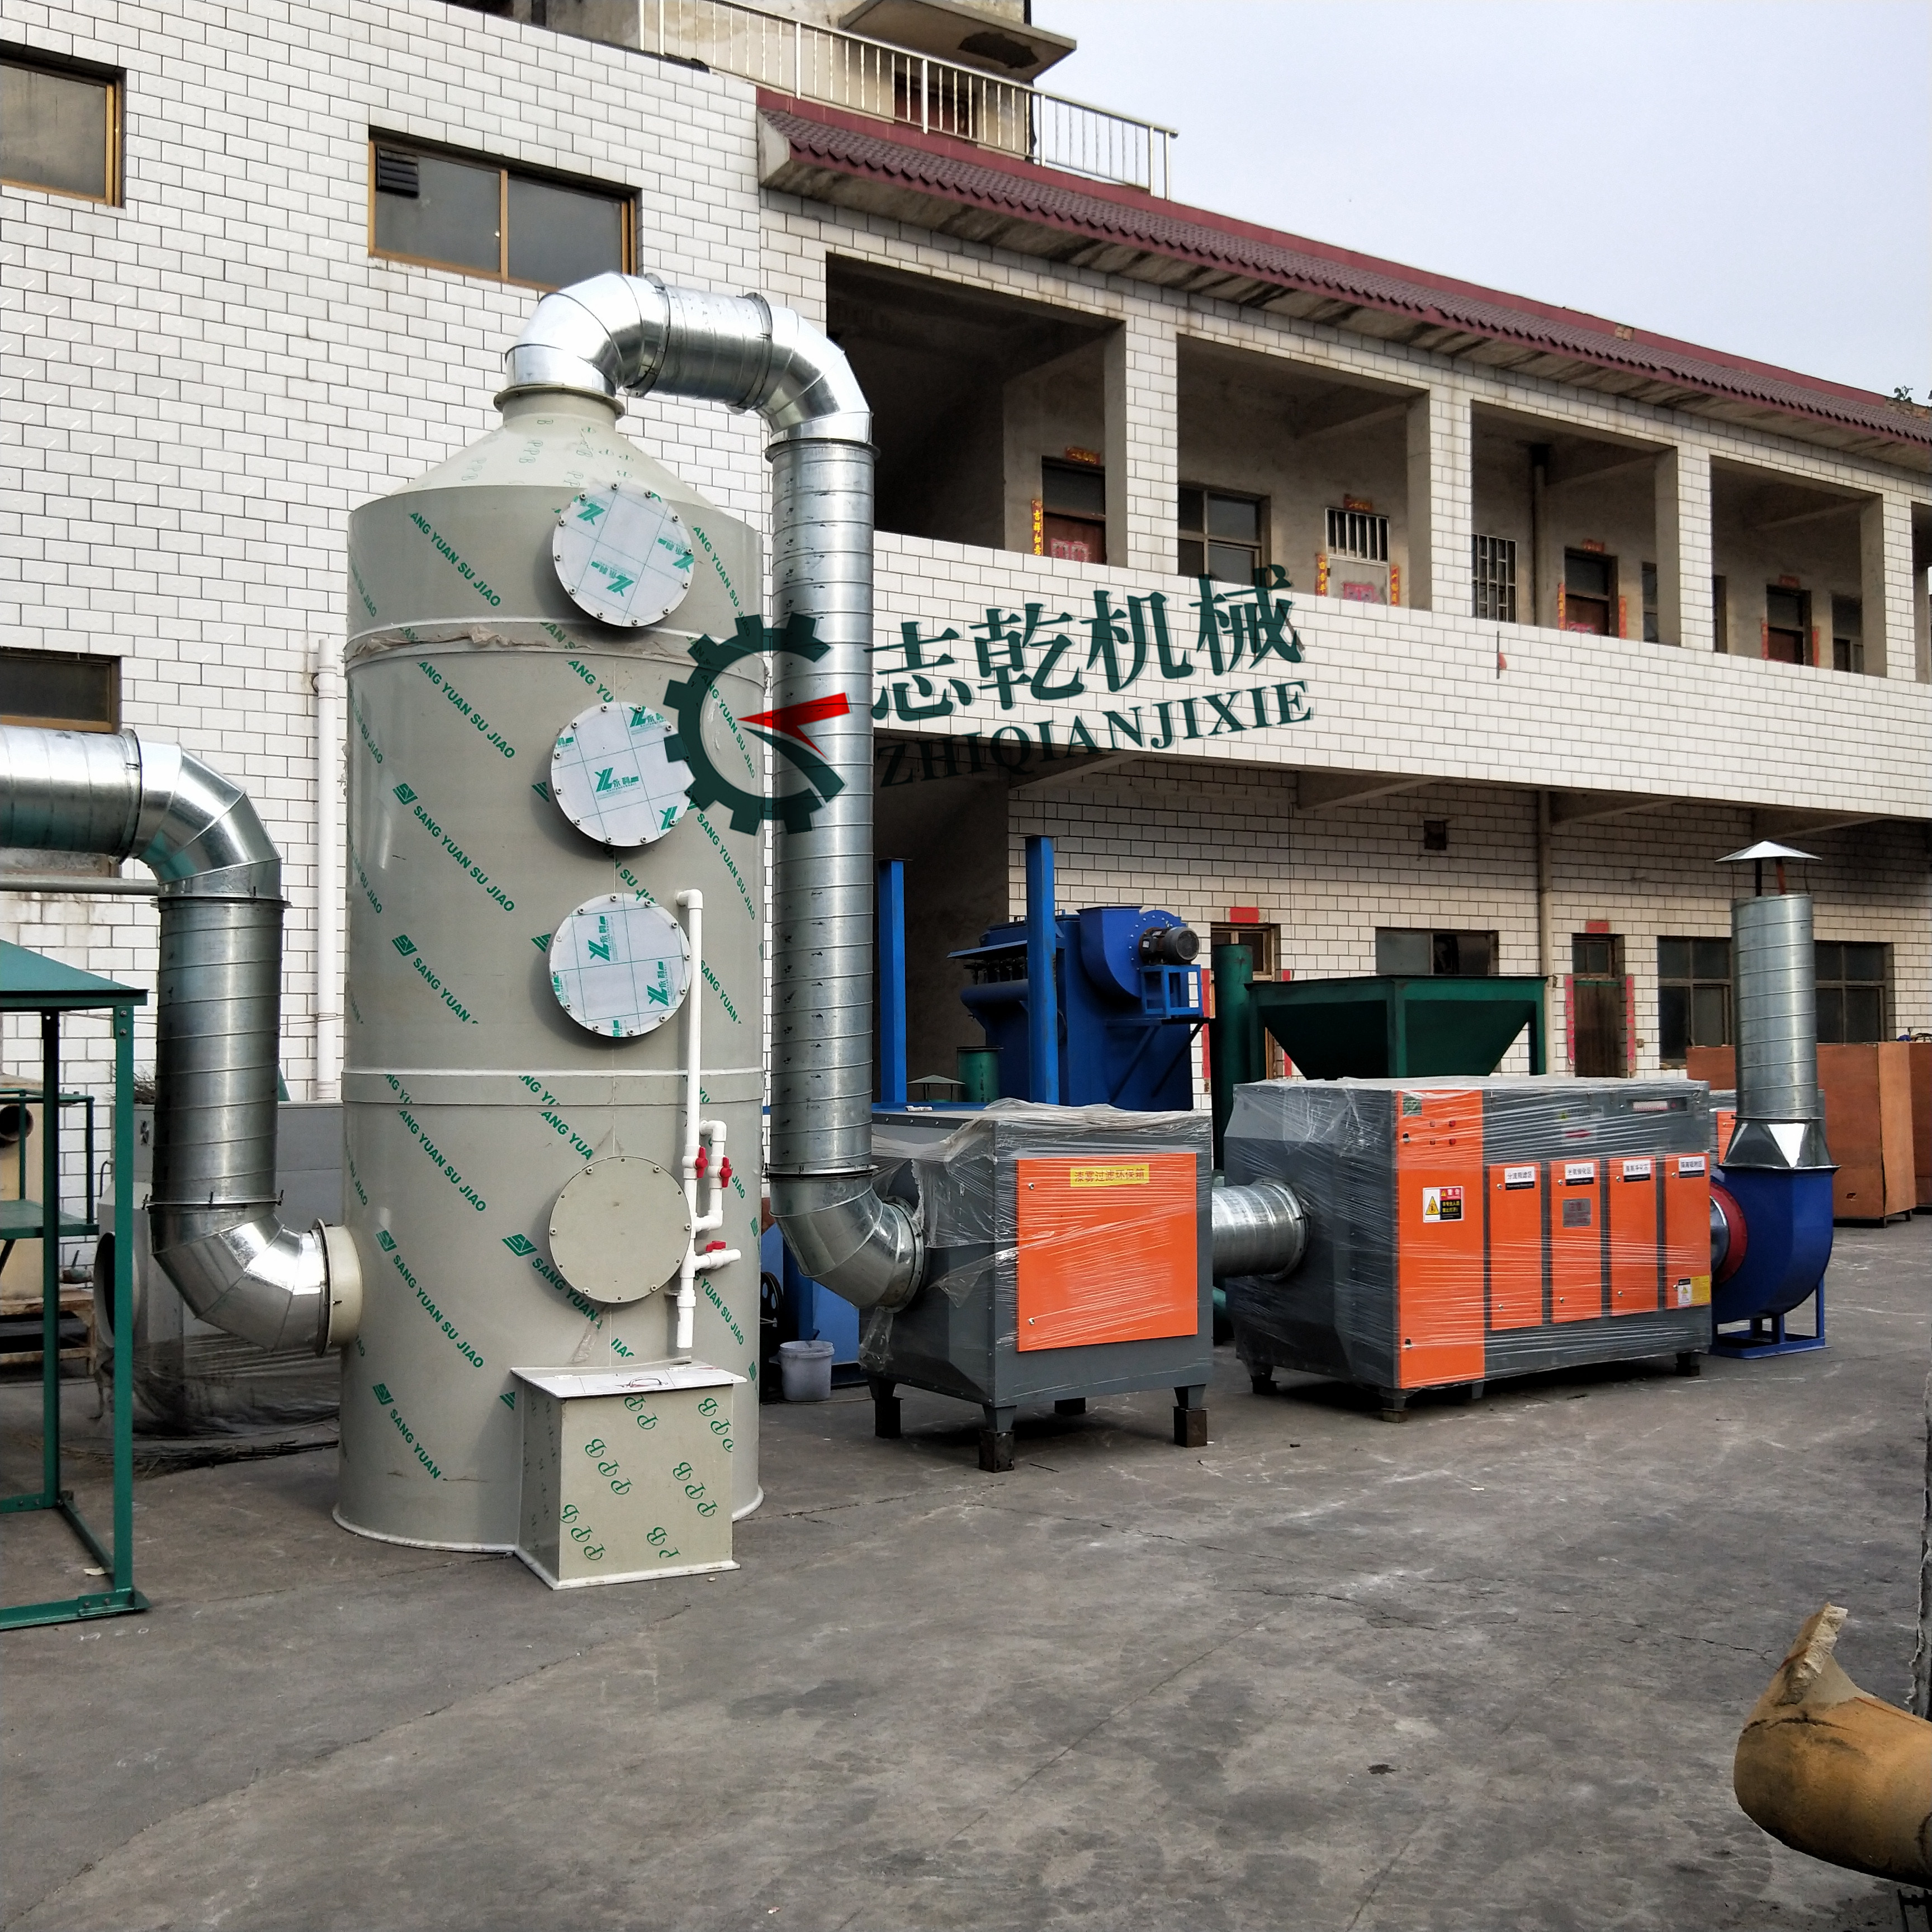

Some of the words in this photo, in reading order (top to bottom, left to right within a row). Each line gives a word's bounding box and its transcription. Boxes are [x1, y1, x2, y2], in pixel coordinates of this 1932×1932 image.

[408, 511, 431, 536] ANG
[430, 535, 460, 566] YUAN
[458, 561, 476, 580] SU
[473, 579, 501, 607] JIAO
[692, 526, 712, 552] ANG
[712, 552, 731, 589] YUAN
[730, 589, 740, 607] SU
[364, 594, 377, 617] JIAO
[566, 660, 596, 685] ANG
[416, 661, 441, 685] ANG
[441, 683, 472, 715] YUAN
[470, 713, 489, 730] SU
[487, 731, 515, 759] JIAO
[700, 674, 719, 699] ANG
[719, 699, 737, 734] YUAN
[736, 733, 746, 751] SU
[744, 754, 755, 779] JIAO
[361, 723, 370, 740] SU
[368, 740, 383, 764] JIAO
[414, 806, 442, 837] SANG
[441, 835, 472, 869] YUAN
[470, 867, 489, 885] SU
[486, 886, 514, 911] JIAO
[620, 869, 638, 887] SU
[697, 813, 720, 845] SANG
[719, 845, 738, 878] YUAN
[737, 877, 746, 894] SU
[744, 896, 755, 921] JIAO
[361, 872, 368, 888] SU
[367, 889, 382, 913] JIAO
[413, 957, 441, 989] SANG
[440, 986, 470, 1024] YUAN
[701, 959, 720, 992] SANG
[719, 989, 738, 1022] YUAN
[398, 1110, 419, 1134] ANG
[419, 1132, 447, 1167] YUAN
[444, 1166, 460, 1185] SU
[459, 1185, 486, 1211] JIAO
[539, 1111, 569, 1135] ANG
[569, 1133, 594, 1161] YUA
[355, 1181, 368, 1206] JIAO
[732, 1175, 745, 1199] JIAO
[393, 1254, 417, 1289] SANG
[416, 1287, 443, 1327] YUAN
[442, 1321, 458, 1340] SU
[456, 1338, 484, 1368] JIAO
[532, 1258, 566, 1290] SANG
[566, 1288, 599, 1322] YUAN
[701, 1278, 722, 1309] YUAN
[721, 1306, 732, 1323] SU
[731, 1323, 744, 1346] JIAO
[391, 1408, 414, 1445] SANG
[411, 1441, 441, 1479] YUAN
[585, 1438, 633, 1495] PPB
[673, 1462, 718, 1517] PPB
[560, 1504, 605, 1561] PPB
